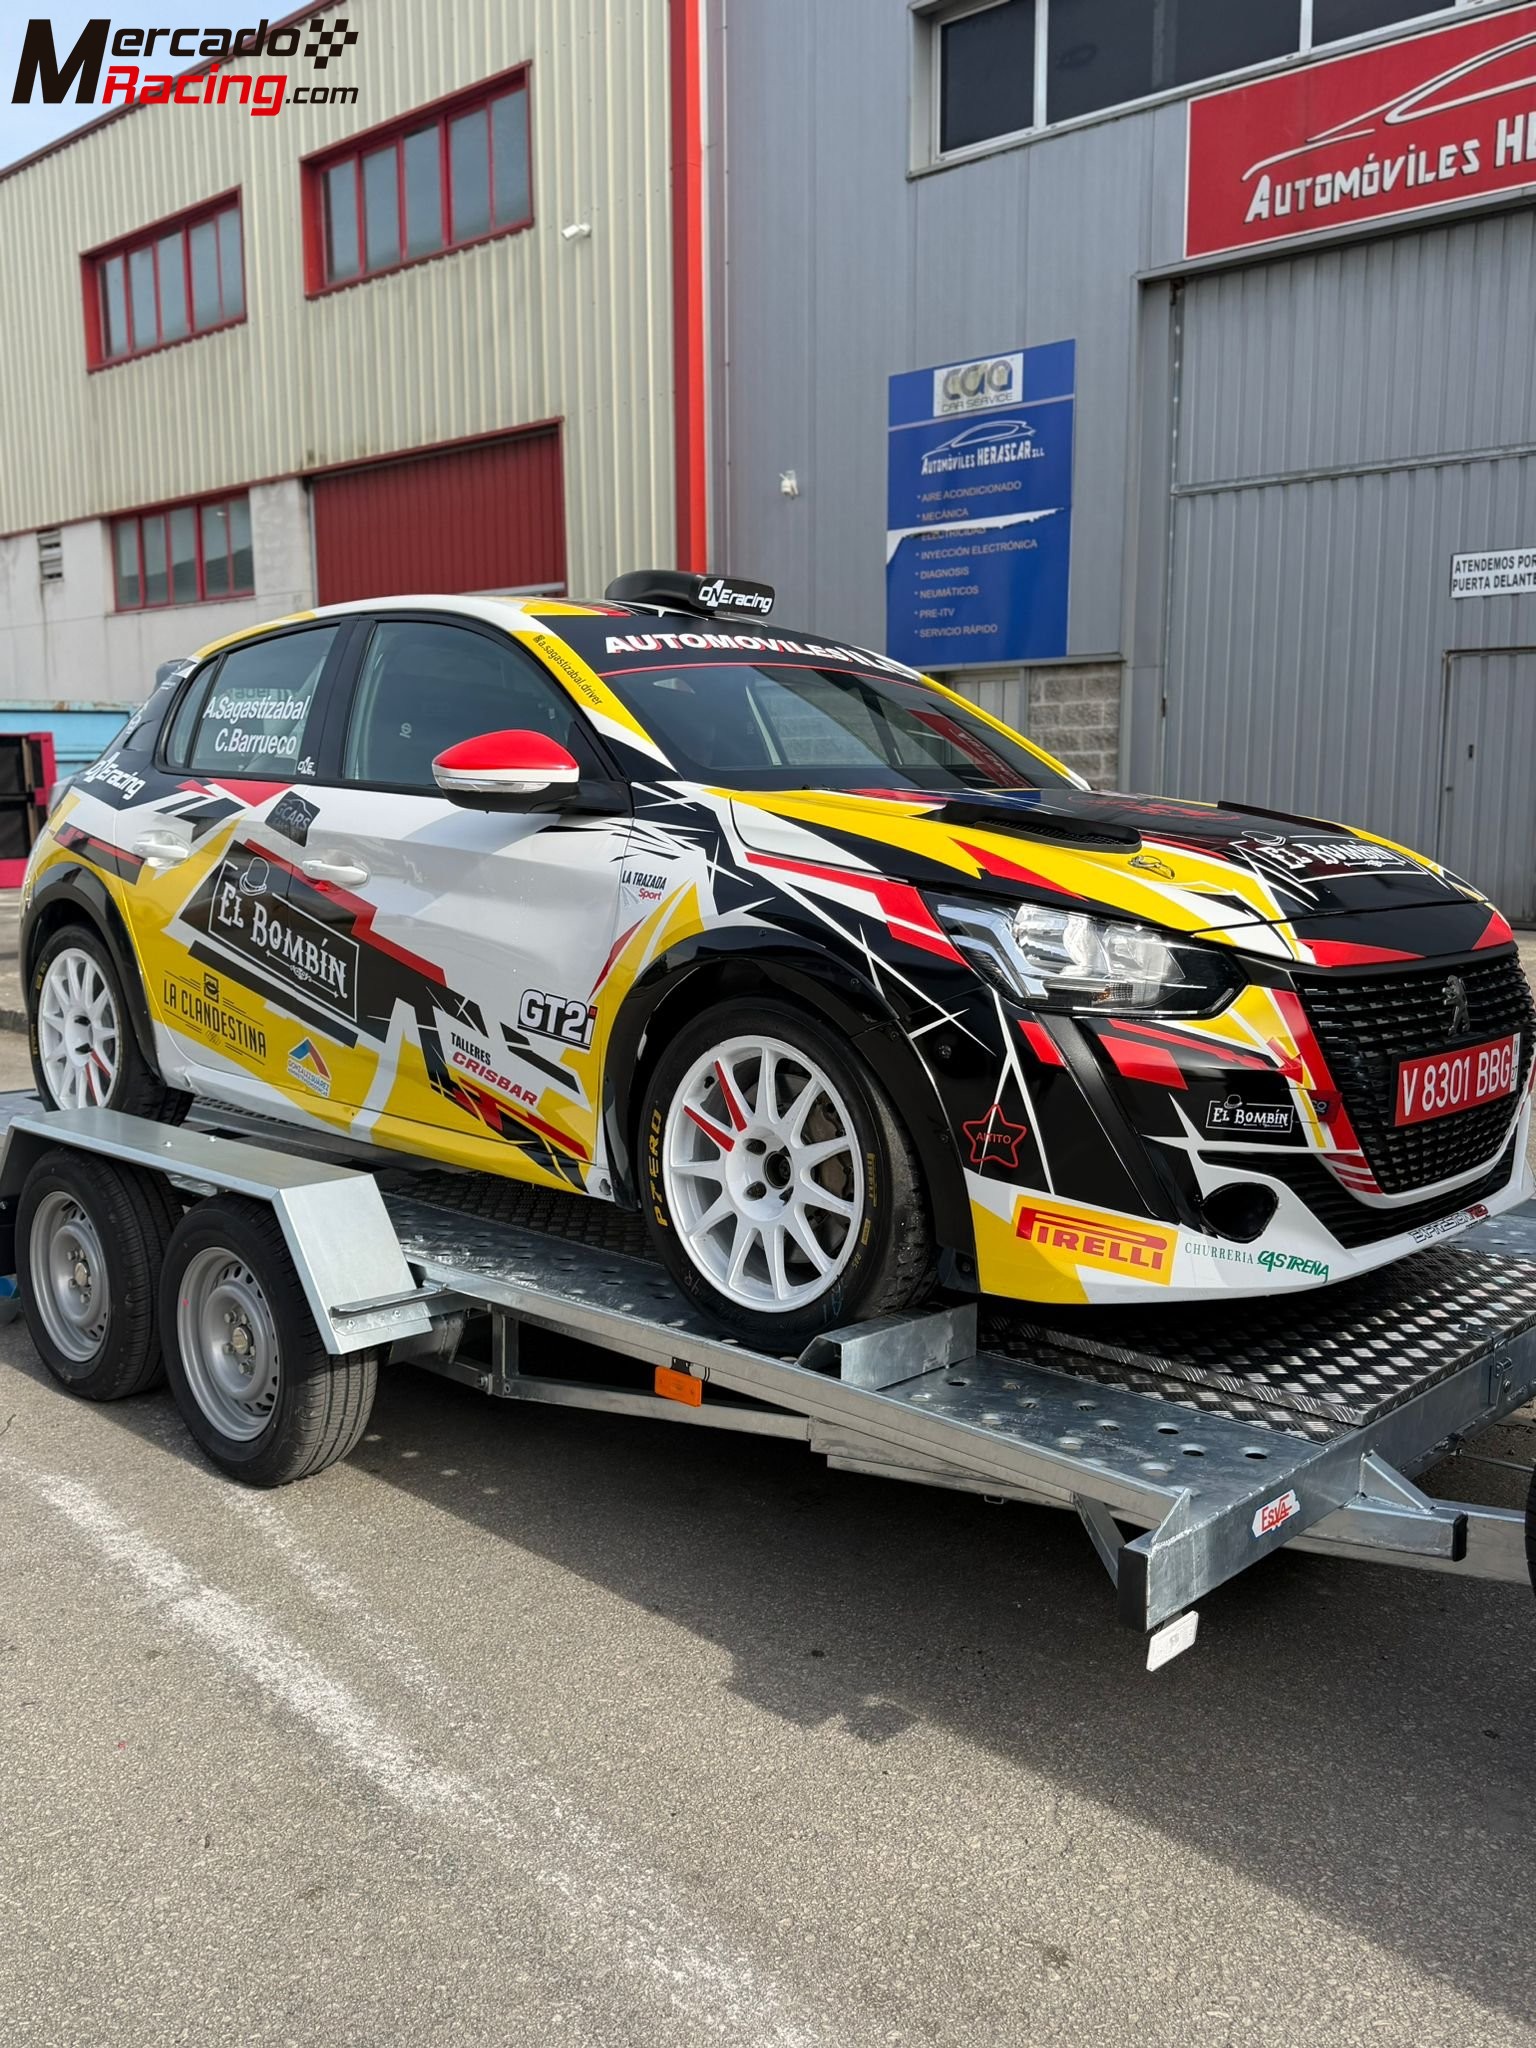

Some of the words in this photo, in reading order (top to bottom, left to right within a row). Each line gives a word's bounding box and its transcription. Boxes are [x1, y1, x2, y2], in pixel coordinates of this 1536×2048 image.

[977, 440, 1031, 467] HERASCAR
[921, 491, 942, 502] AIRE
[943, 481, 1022, 500] ACONDICIONADO
[921, 508, 969, 521] MECÁNICA
[921, 544, 970, 560] INYECCIÓN
[972, 539, 1038, 555] ELECTRÓNICA
[920, 567, 970, 580] DIAGNOSIS
[1455, 556, 1515, 574] ATENDEMOS
[920, 585, 980, 599] NEUMÁTICOS
[1452, 576, 1490, 592] PUERTA
[919, 608, 955, 619] PRE-ITV
[919, 626, 961, 638] SERVICIO
[963, 624, 998, 636] RÁPIDO
[605, 633, 852, 663] AUTOMOVILES
[622, 870, 632, 884] LA
[633, 871, 667, 890] TRAZADA
[638, 888, 662, 900] Sport
[217, 881, 245, 929] EL
[250, 901, 348, 999] BOMBÍN
[163, 979, 177, 1009] LA
[181, 986, 267, 1058] CLANDESTINA
[450, 1032, 491, 1066] TALLERES
[452, 1051, 538, 1106] CRISBAR
[1403, 1067, 1419, 1116] V
[1421, 1055, 1471, 1112] 8301
[1476, 1044, 1511, 1098] BBG
[1212, 1108, 1229, 1124] EL
[1236, 1108, 1289, 1127] BOMBÍN
[1015, 1206, 1168, 1270] PIRELLI
[1184, 1242, 1254, 1265] CHURRERIA
